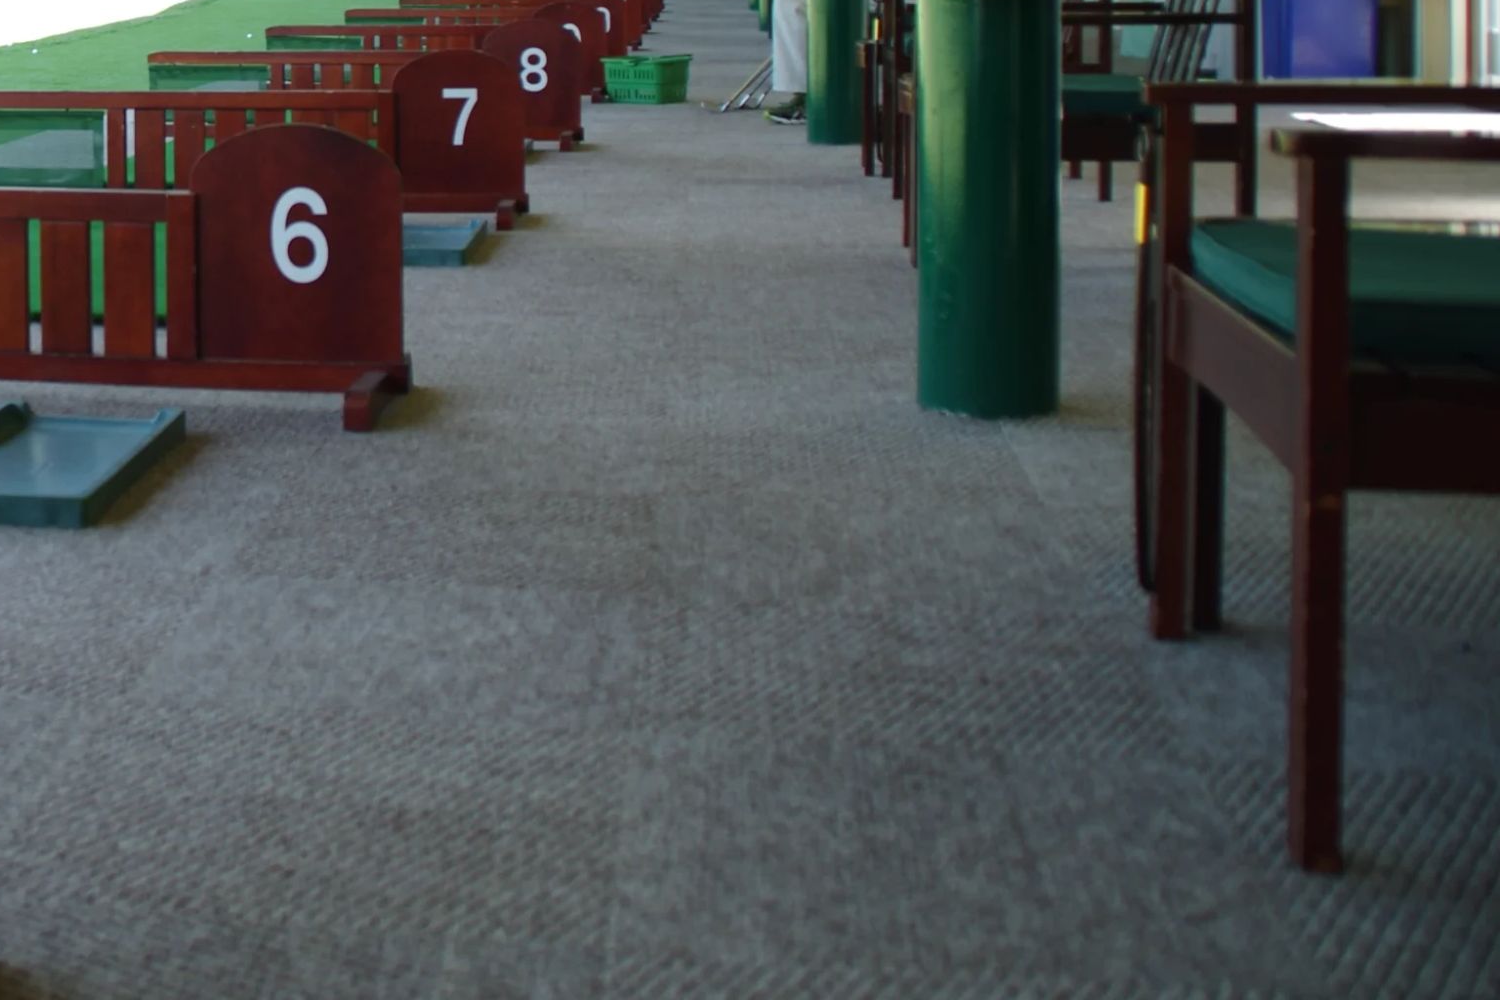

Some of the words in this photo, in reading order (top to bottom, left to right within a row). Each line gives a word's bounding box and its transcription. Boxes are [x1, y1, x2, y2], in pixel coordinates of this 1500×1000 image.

[520, 47, 548, 92] 8
[442, 88, 478, 146] 7
[271, 187, 330, 283] 6
